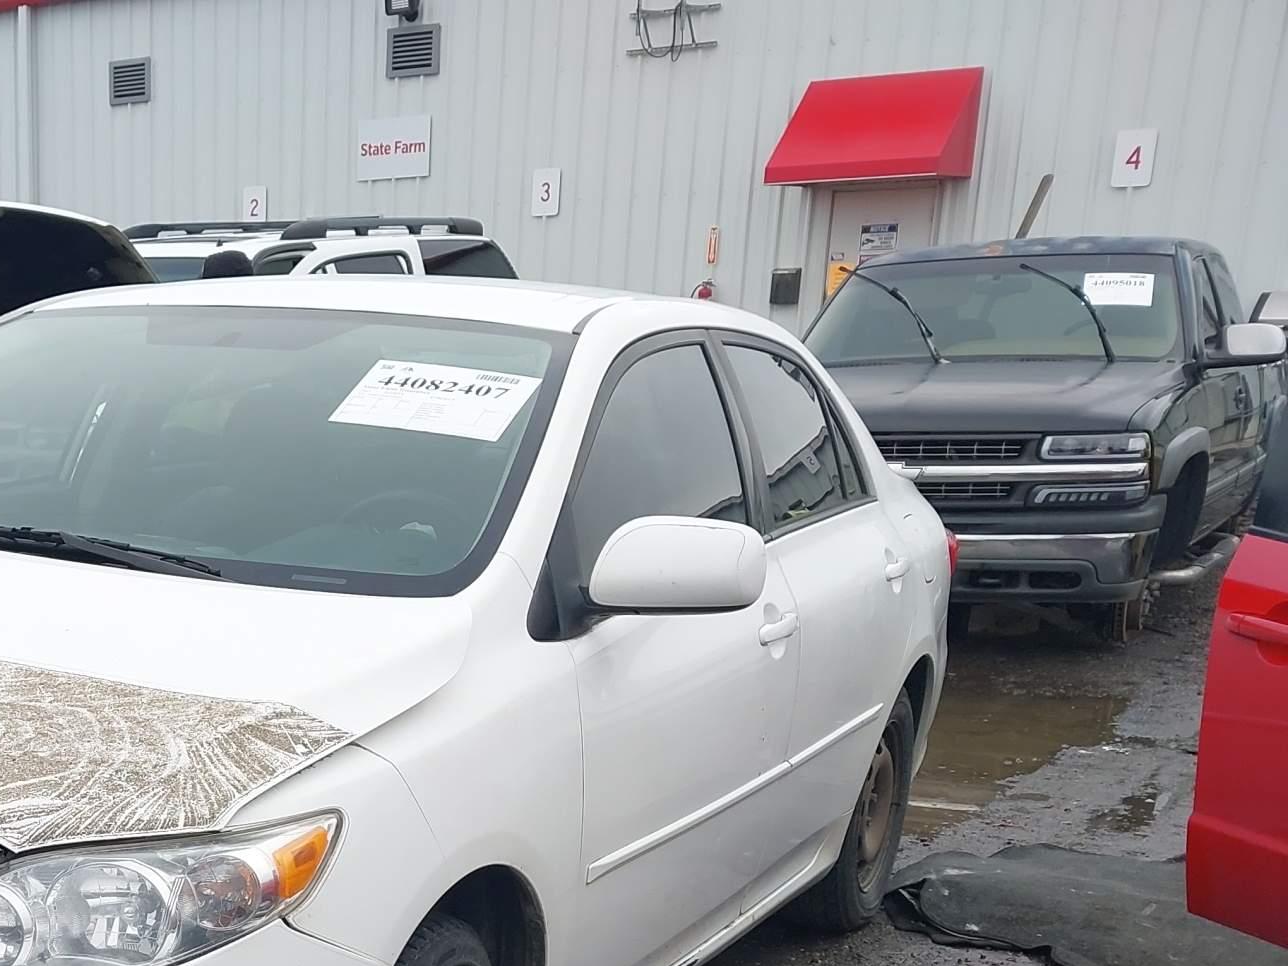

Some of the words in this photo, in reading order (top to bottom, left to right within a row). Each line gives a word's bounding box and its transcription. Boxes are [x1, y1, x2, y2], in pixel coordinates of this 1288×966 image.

[360, 142, 392, 157] State
[394, 140, 426, 154] Farm
[1125, 145, 1142, 170] 4
[540, 182, 551, 202] 3
[250, 198, 259, 217] 2
[378, 374, 512, 400] 44082407
